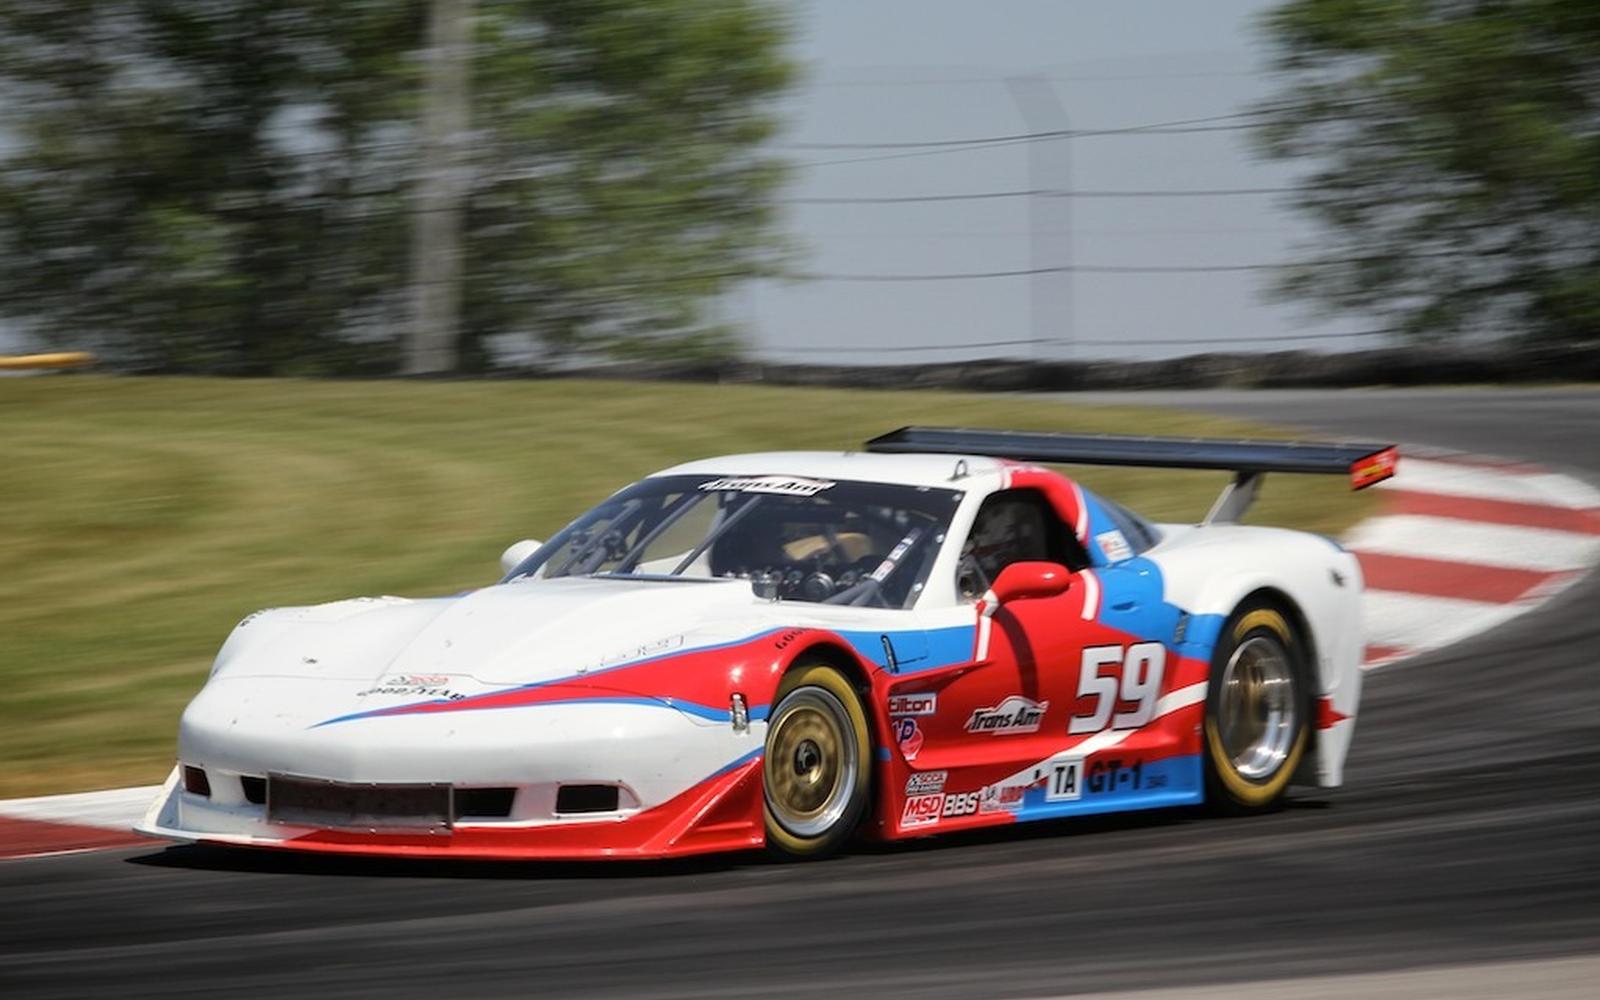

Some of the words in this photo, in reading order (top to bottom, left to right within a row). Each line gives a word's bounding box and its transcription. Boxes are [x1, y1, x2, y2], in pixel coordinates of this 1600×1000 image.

[1067, 642, 1166, 734] 59
[971, 711, 1012, 729] Trans
[1012, 707, 1039, 726] Am
[1054, 765, 1077, 795] TA
[1088, 759, 1144, 793] GT-1
[905, 796, 941, 816] MSD
[943, 793, 979, 816] BBS
